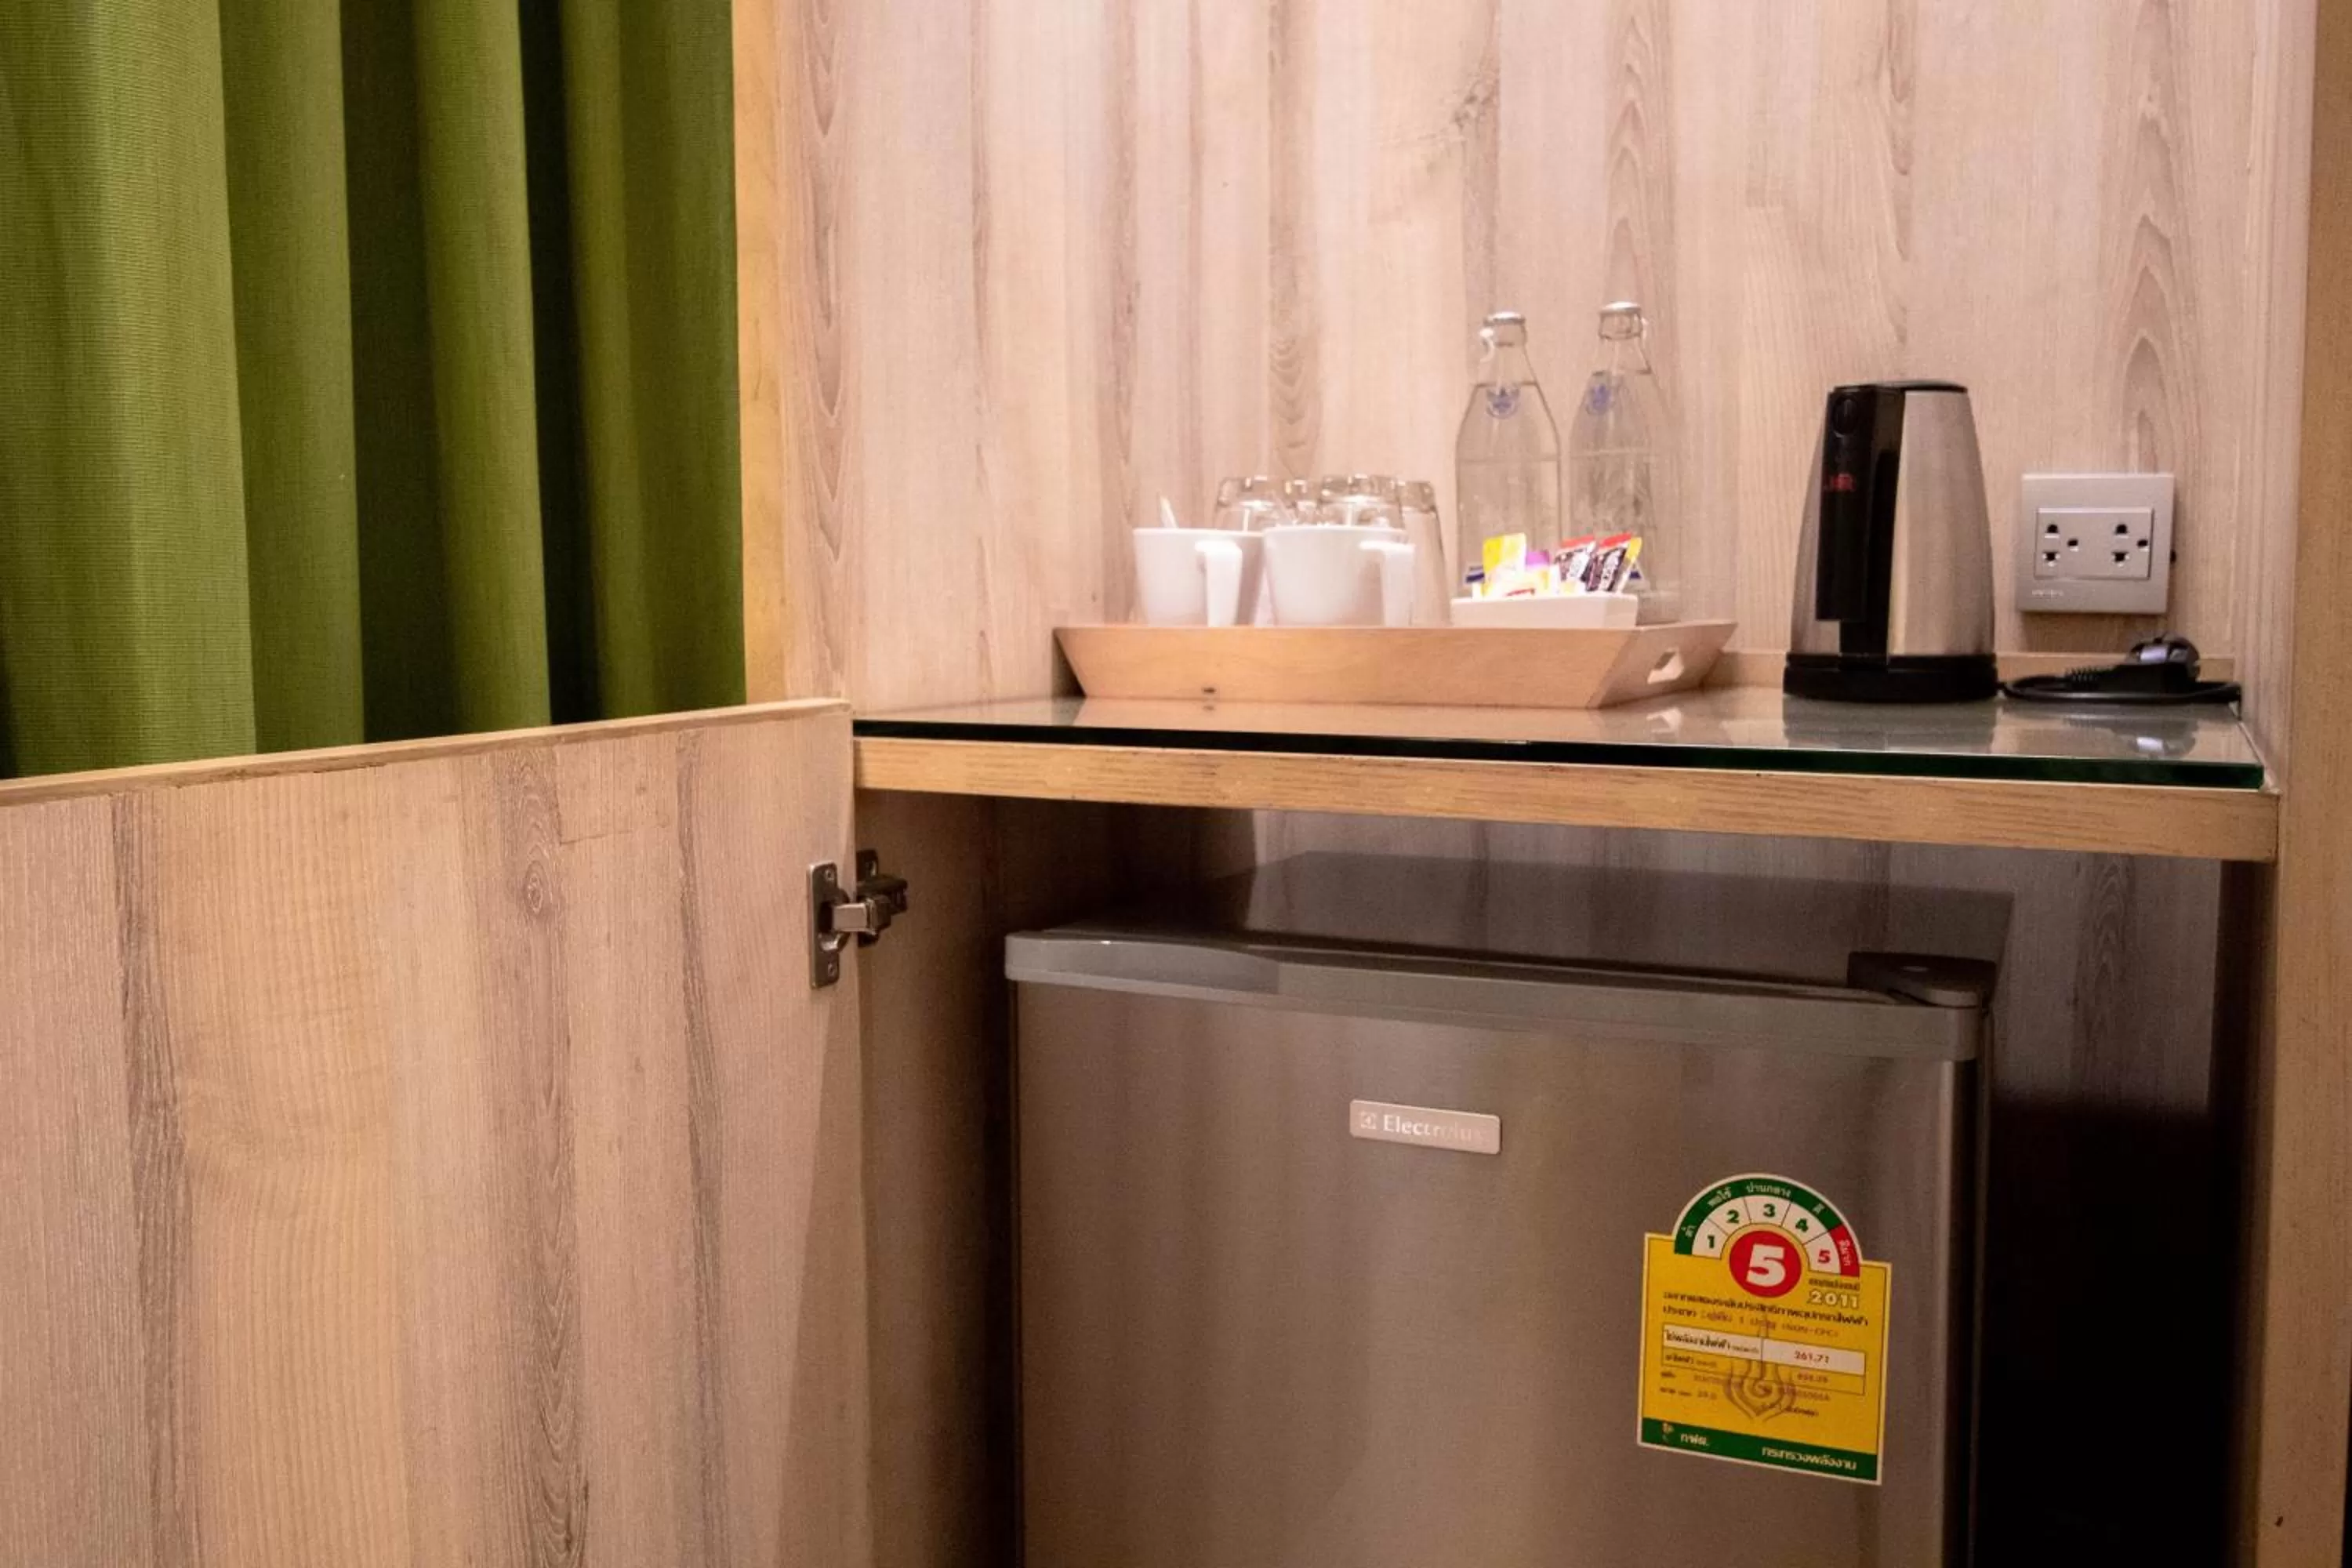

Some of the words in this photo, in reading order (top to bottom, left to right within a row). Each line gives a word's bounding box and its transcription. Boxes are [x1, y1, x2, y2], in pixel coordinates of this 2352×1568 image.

[1383, 1113, 1480, 1142] Electrolu
[1746, 1181, 1791, 1199] ปานกลาง
[1707, 1235, 1715, 1249] 1
[1727, 1210, 1740, 1224] 2
[1763, 1203, 1776, 1217] 3
[1795, 1218, 1809, 1232] 4
[1818, 1248, 1831, 1263] 5
[1745, 1243, 1787, 1287] 5
[1809, 1289, 1860, 1309] 2011
